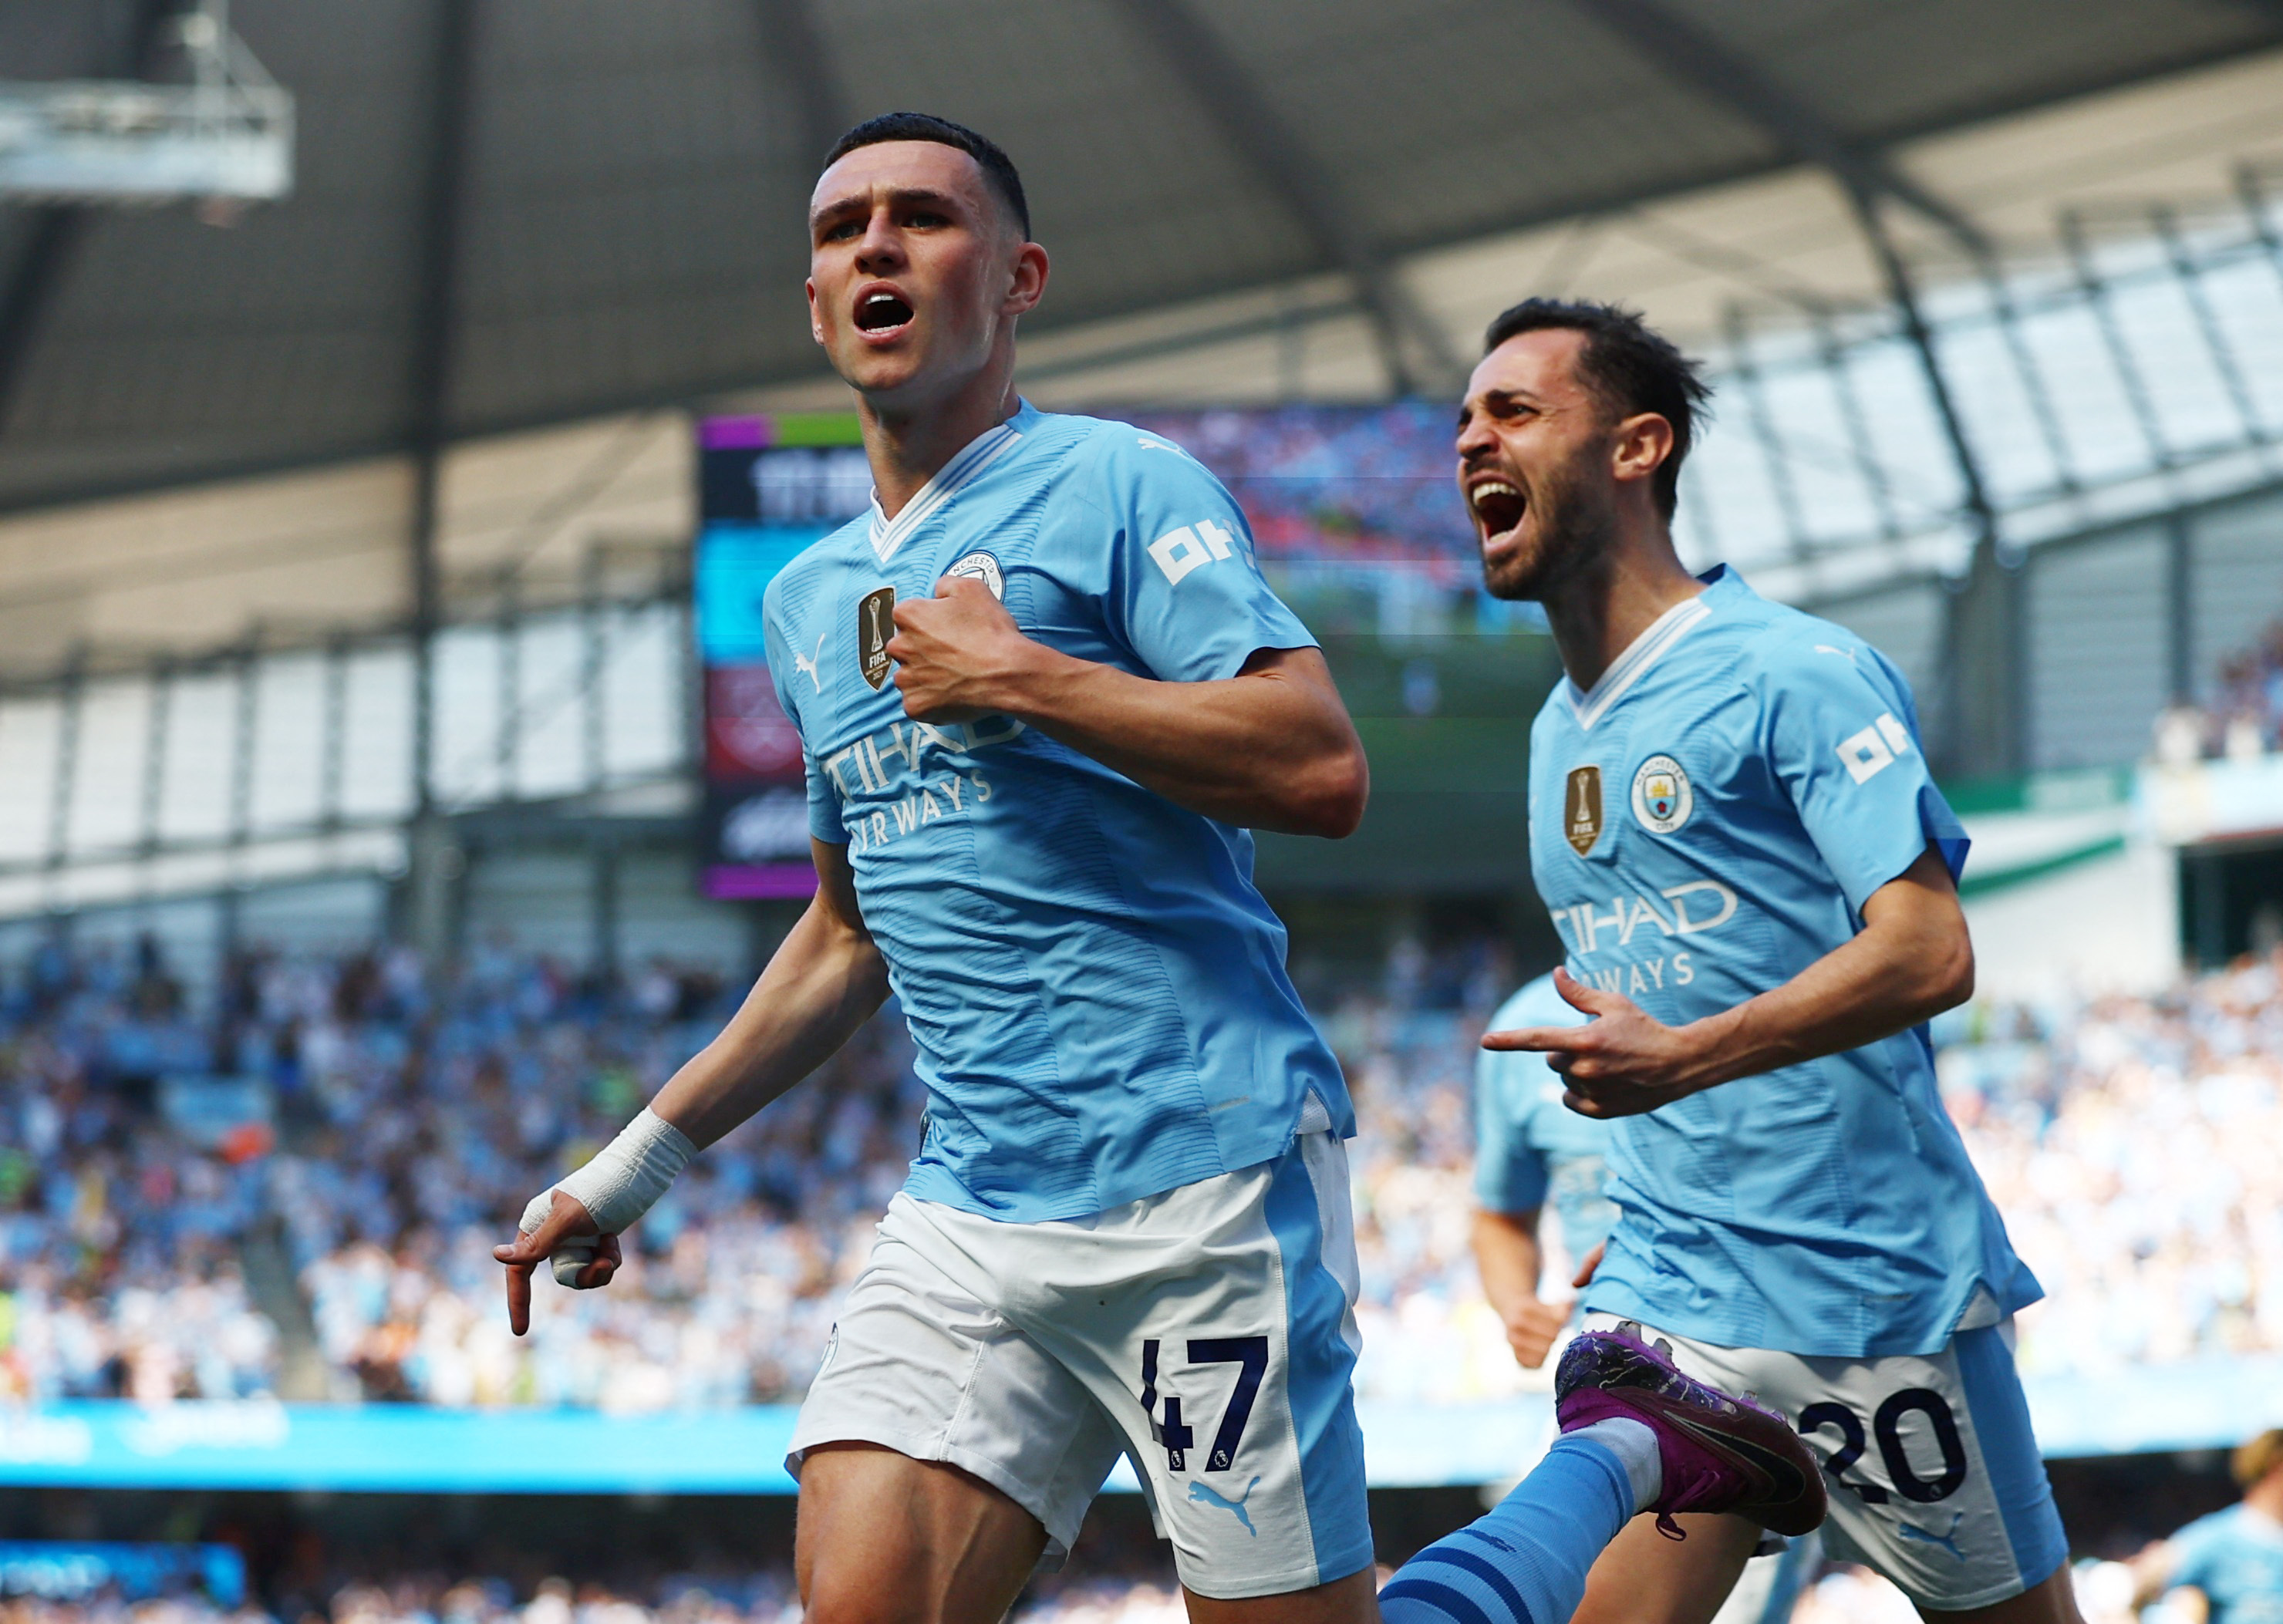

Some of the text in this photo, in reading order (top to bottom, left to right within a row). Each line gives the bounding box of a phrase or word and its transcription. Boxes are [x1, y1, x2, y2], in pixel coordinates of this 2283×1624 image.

[953, 556, 995, 575] NCHESTER
[869, 651, 886, 669] FIFA
[821, 716, 1027, 804] TIHAD
[850, 769, 992, 854] IRWAYS
[1582, 952, 1695, 996] WAYS
[1140, 1335, 1269, 1472] 47
[1799, 1387, 1966, 1504] 20
